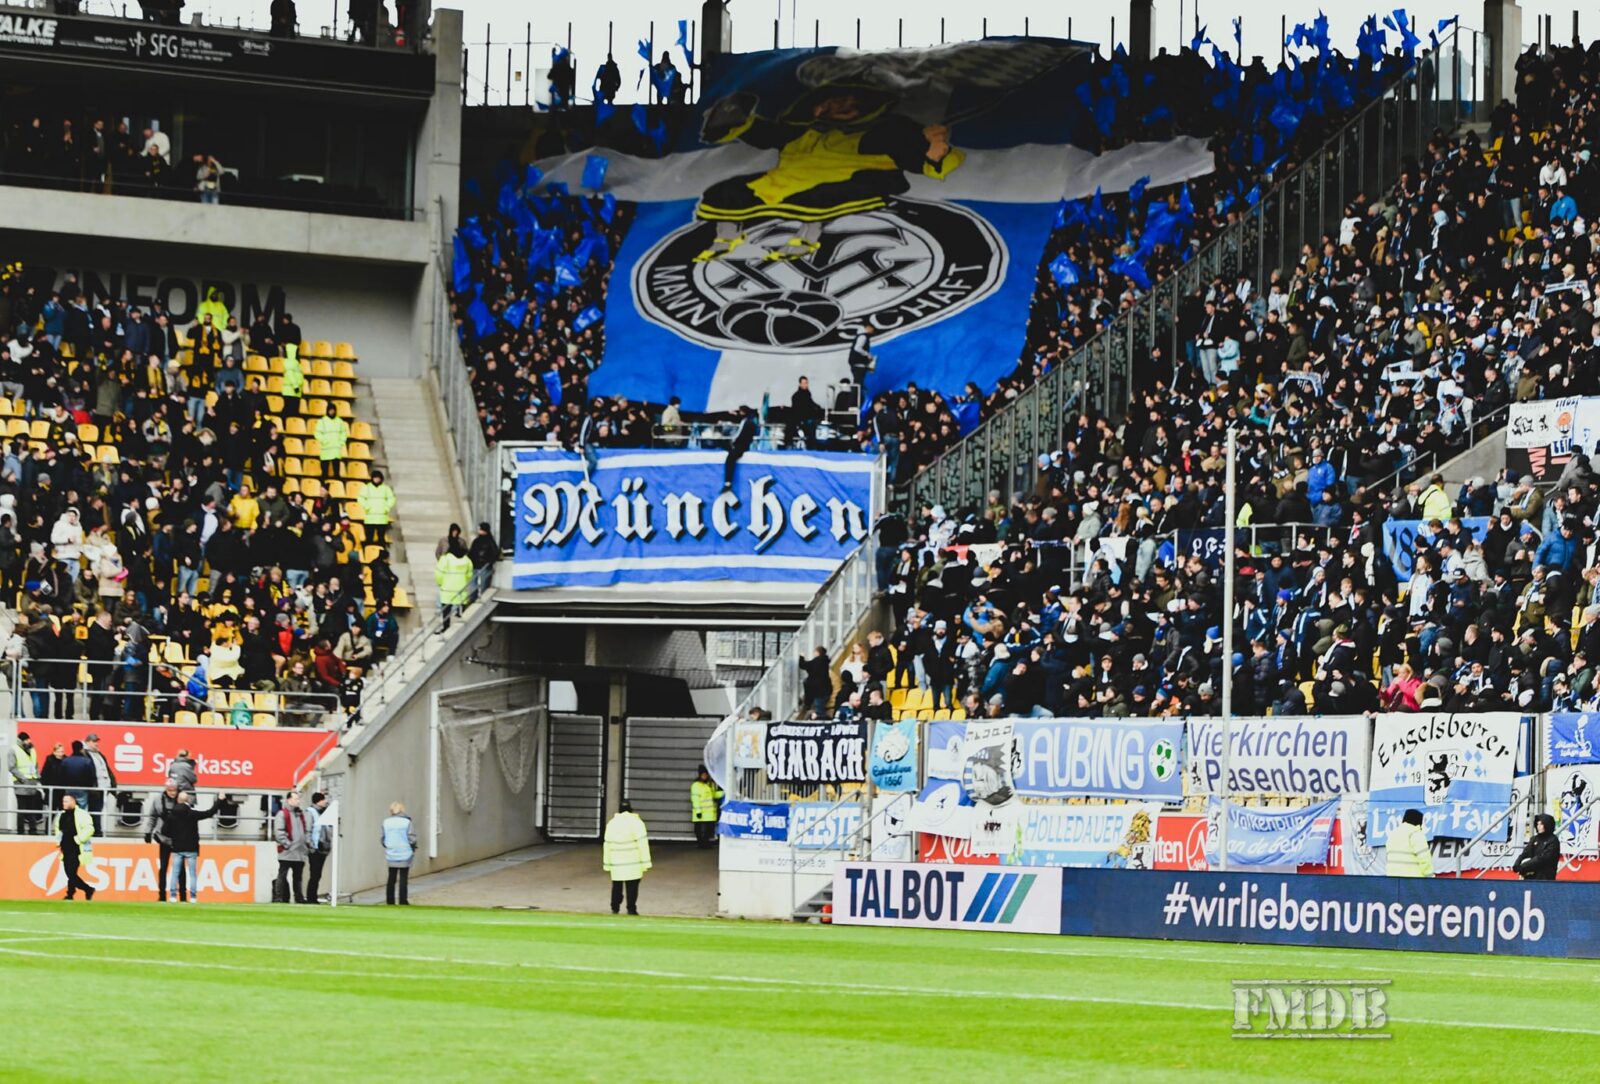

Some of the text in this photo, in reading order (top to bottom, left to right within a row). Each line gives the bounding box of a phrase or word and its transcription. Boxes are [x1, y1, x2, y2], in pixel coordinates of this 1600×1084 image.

[150, 33, 178, 58] SFG
[653, 262, 984, 340] MANN SCHAFT
[522, 474, 869, 555] München
[767, 737, 865, 782] SIMBACH
[1028, 726, 1146, 790] AUBING
[1190, 721, 1348, 758] Vierkirchen
[152, 753, 254, 778] Spkasse
[1206, 759, 1361, 794] Pasenbach
[1025, 810, 1124, 843] HOLLEDAUER
[86, 856, 250, 893] STAAG
[845, 868, 964, 922] TALBOT
[1163, 880, 1545, 951] #wirliebenunserenjob
